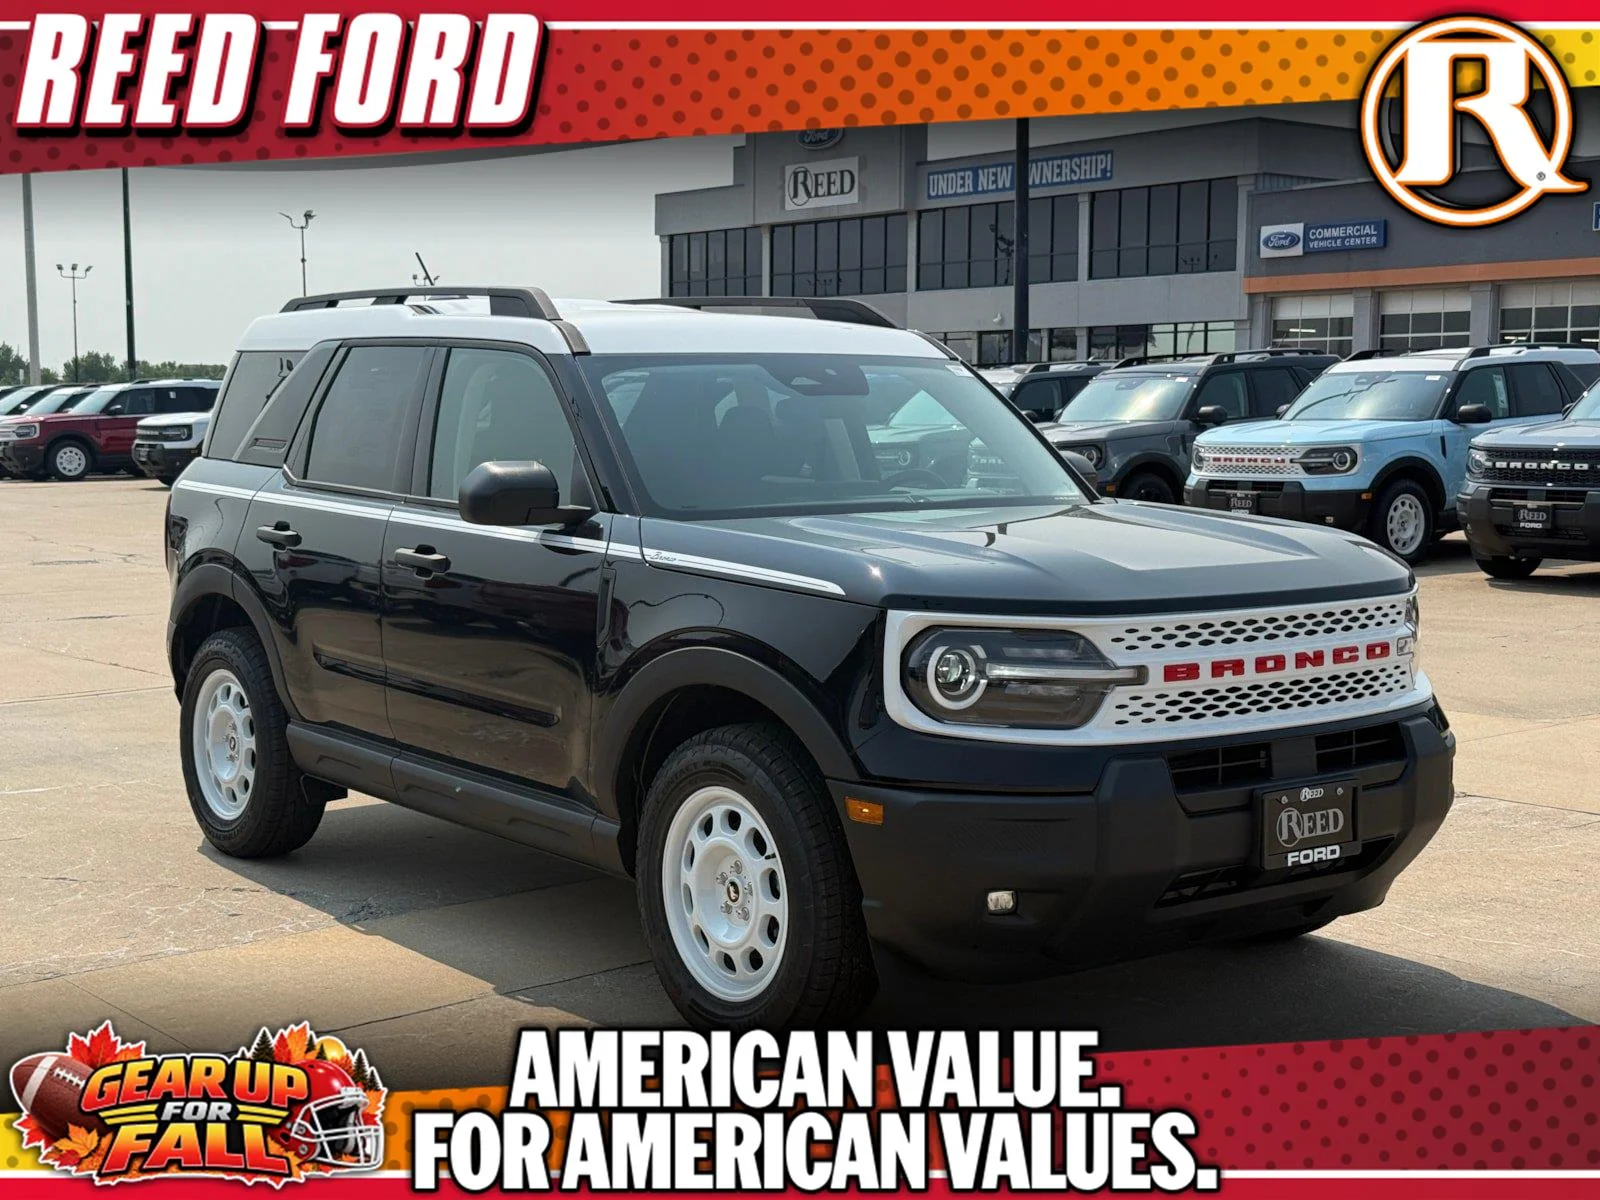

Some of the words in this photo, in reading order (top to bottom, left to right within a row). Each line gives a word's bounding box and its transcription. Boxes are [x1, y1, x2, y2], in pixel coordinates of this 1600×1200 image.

[929, 170, 973, 197] UNDER
[978, 165, 1013, 191] NEW
[1028, 153, 1112, 185] WNERSHIP!
[1309, 225, 1378, 239] COMMERCIAL
[1268, 234, 1292, 247] Ford
[1309, 239, 1342, 249] VEHICLE
[1344, 236, 1377, 246] CENTER
[1212, 456, 1286, 464] BRONCO
[1495, 461, 1589, 470] BRONCO
[1163, 641, 1391, 683] BRONCO
[1287, 844, 1341, 867] FORD
